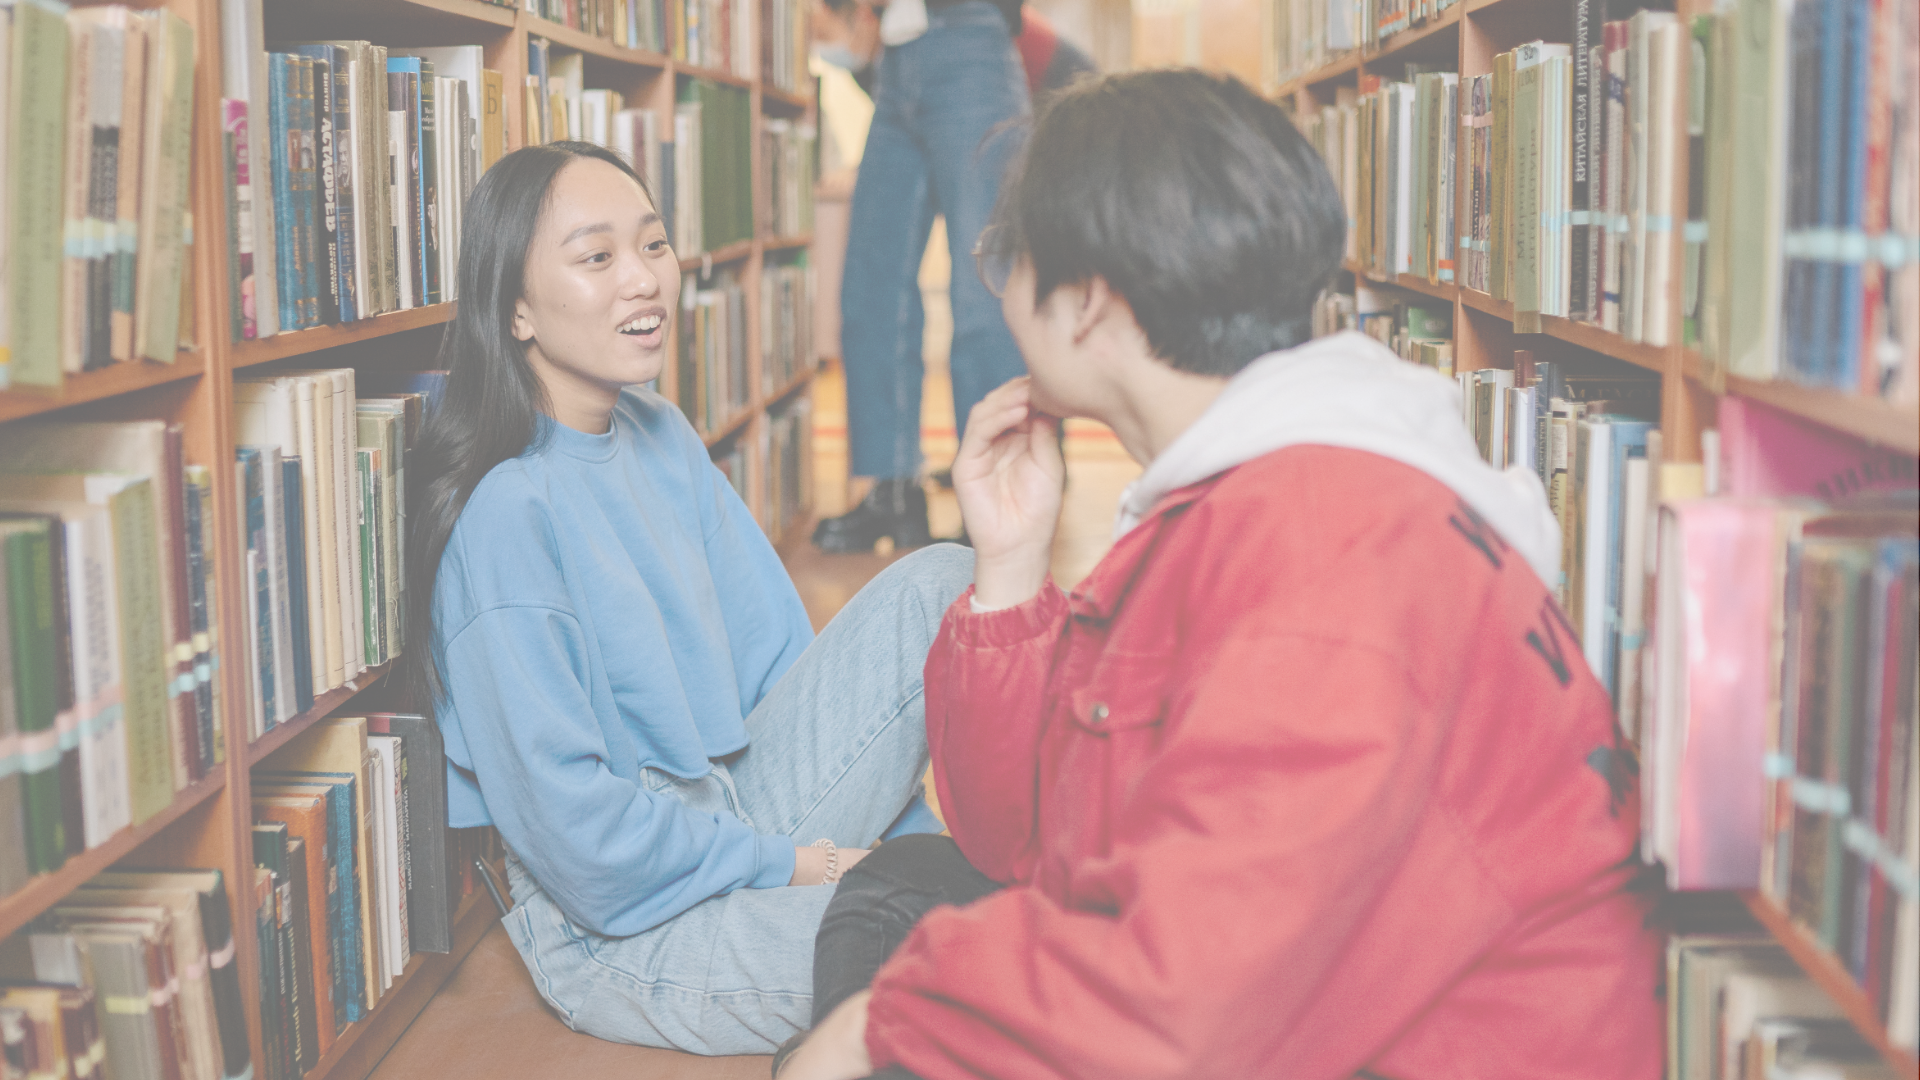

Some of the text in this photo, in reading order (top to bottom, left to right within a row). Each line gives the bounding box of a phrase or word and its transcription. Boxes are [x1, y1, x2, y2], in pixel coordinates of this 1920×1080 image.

[486, 83, 498, 115] Б
[1574, 0, 1589, 182] КИТАЙСКАЯ ЛИТЕРАТУРА
[320, 117, 336, 232] АСТАФЬЕВ
[1517, 146, 1526, 260] Мировая
